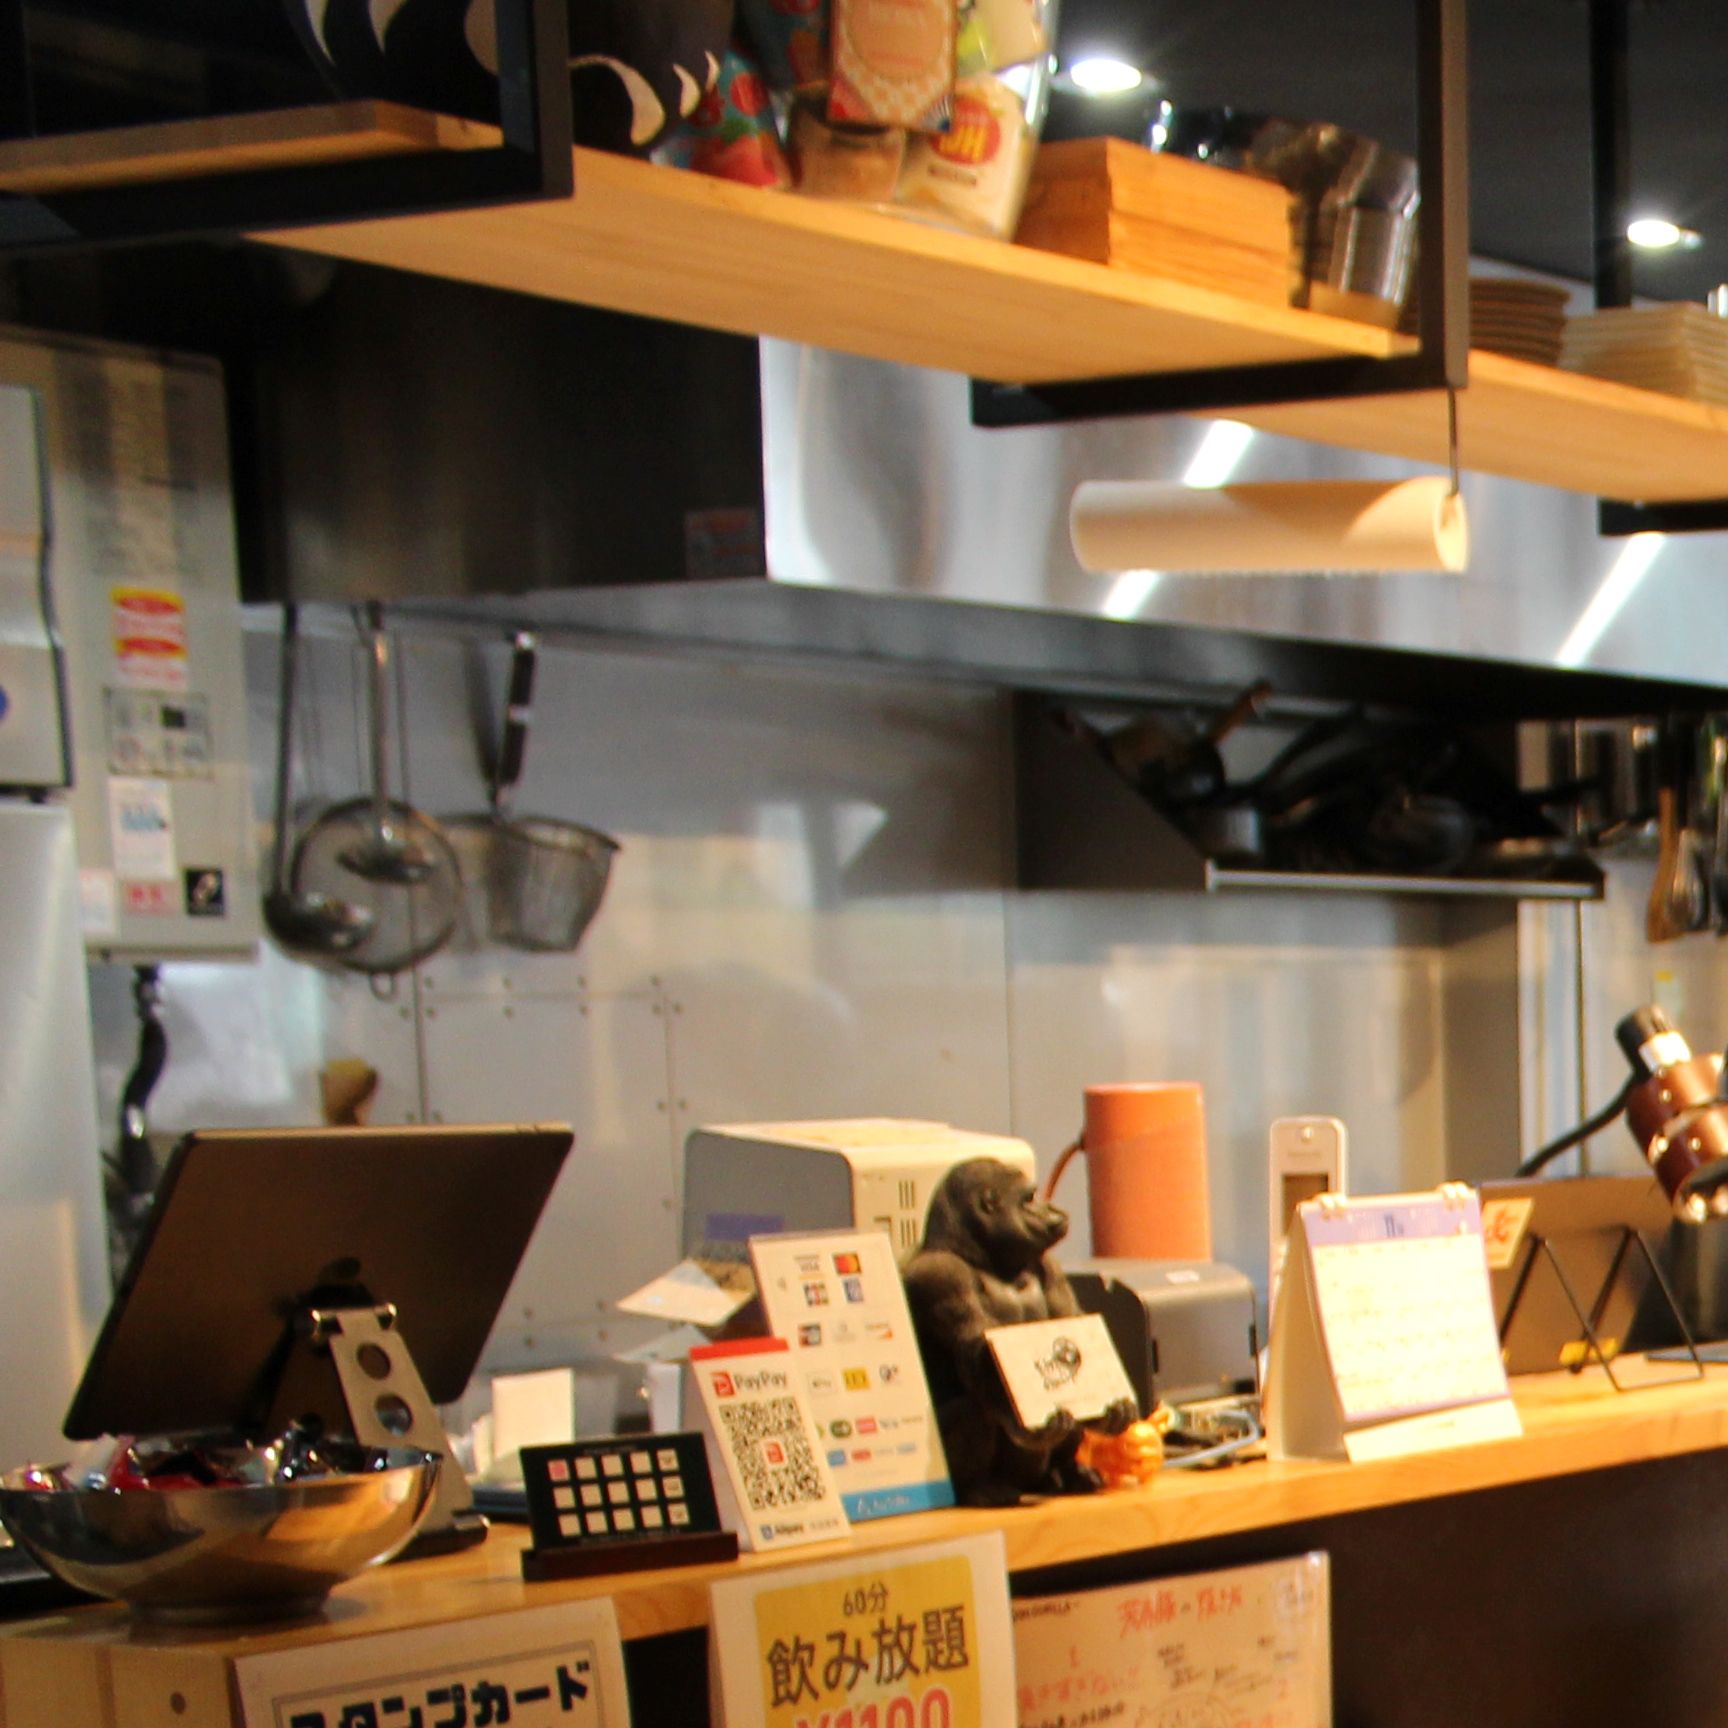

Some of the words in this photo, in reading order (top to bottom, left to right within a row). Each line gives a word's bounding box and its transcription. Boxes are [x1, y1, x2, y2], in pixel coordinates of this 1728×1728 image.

[735, 1371, 787, 1392] PayPay
[843, 1581, 889, 1617] 60分
[767, 1605, 969, 1709] 飲み放題
